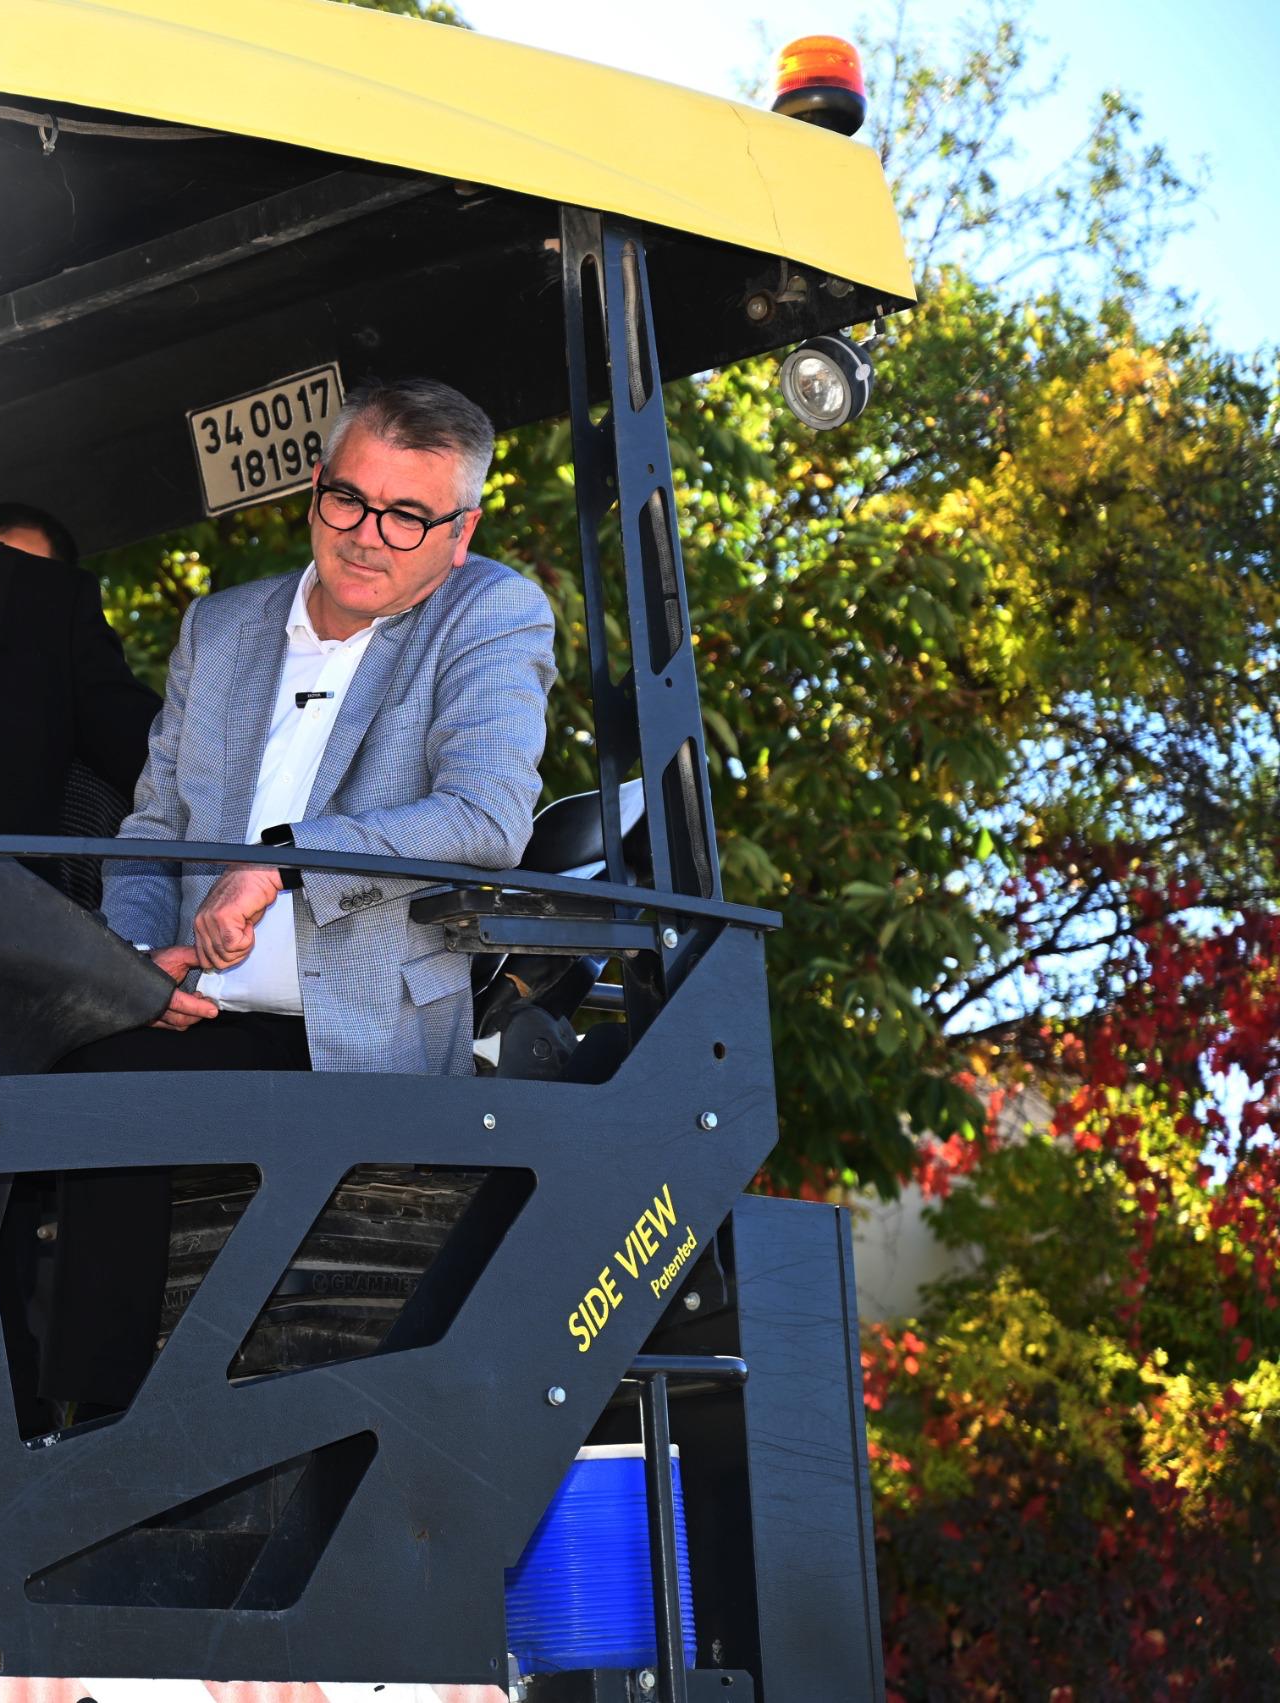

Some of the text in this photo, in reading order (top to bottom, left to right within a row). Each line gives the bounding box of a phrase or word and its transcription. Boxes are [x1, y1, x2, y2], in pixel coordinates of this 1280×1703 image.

[231, 431, 322, 492] 18198
[569, 1183, 677, 1352] SIDE VIEW
[650, 1226, 698, 1299] Patented
